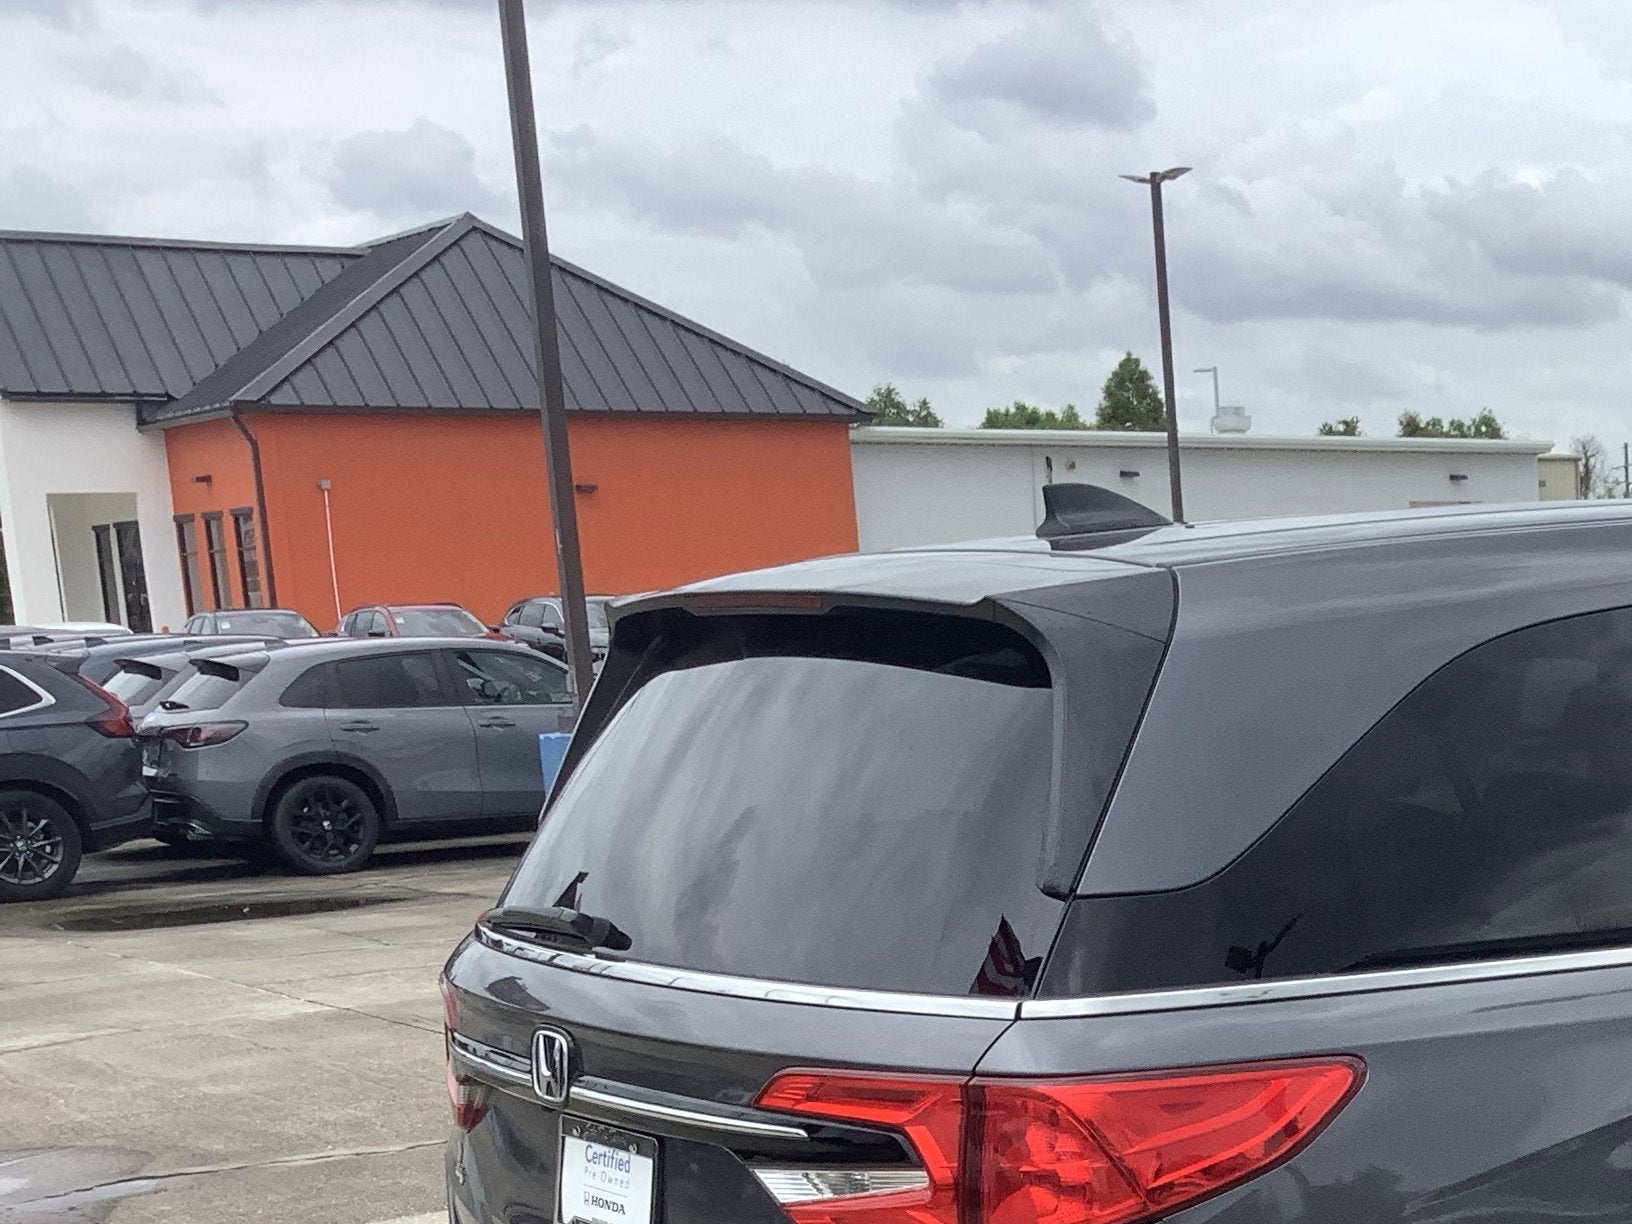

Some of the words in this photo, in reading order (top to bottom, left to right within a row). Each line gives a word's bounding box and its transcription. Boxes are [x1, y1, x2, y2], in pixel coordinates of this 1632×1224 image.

[584, 1144, 632, 1174] Certified
[583, 1165, 630, 1190] Pre-Owned
[590, 1195, 626, 1216] HONDA
